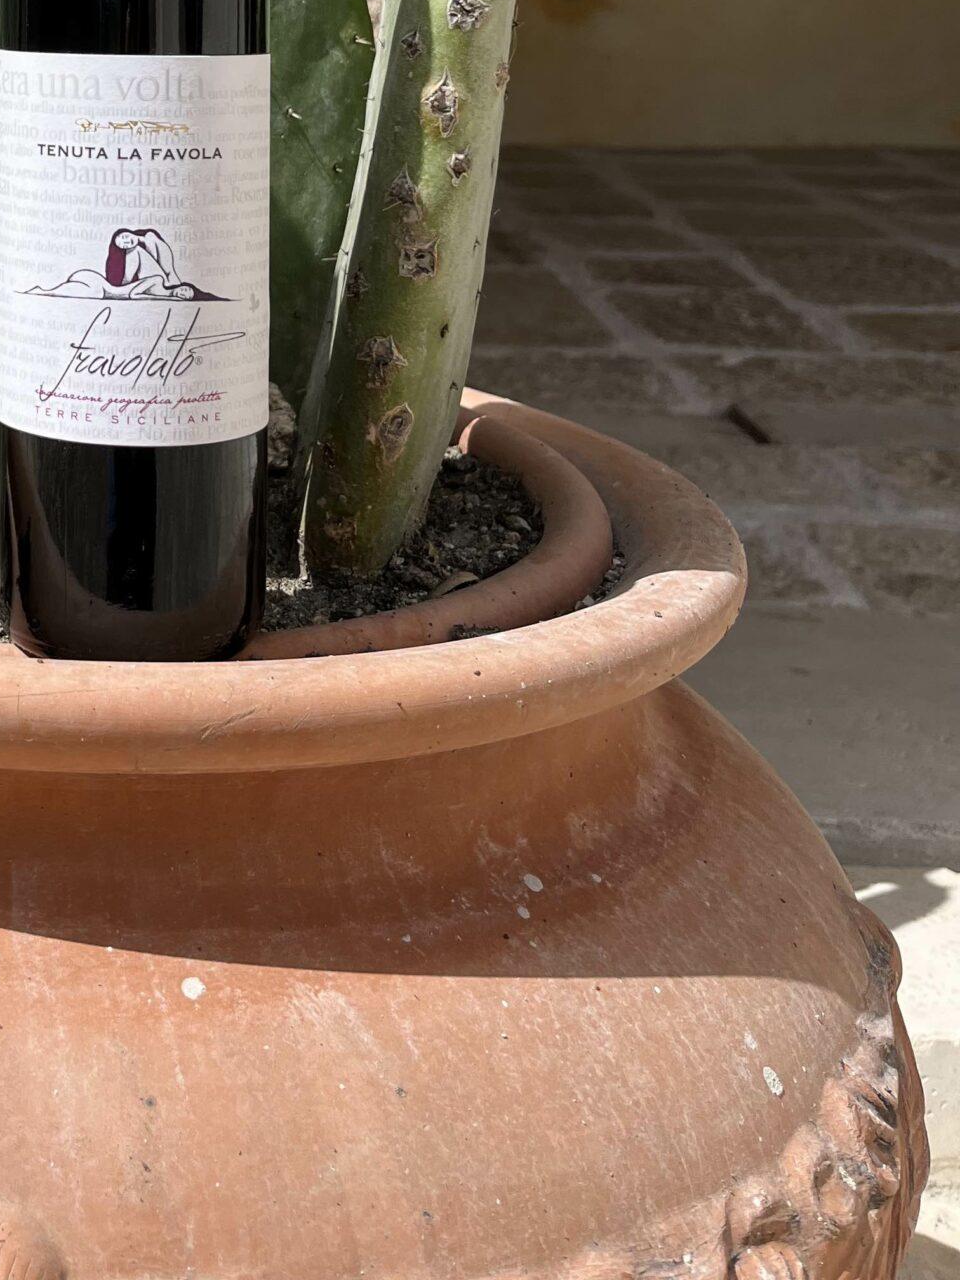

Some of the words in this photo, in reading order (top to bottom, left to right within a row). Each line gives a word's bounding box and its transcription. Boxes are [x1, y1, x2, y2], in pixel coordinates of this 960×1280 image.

[37, 71, 102, 101] una
[114, 66, 207, 102] volta
[37, 143, 108, 160] TENUTA
[117, 147, 143, 161] LA
[150, 146, 223, 161] FAVOLA
[62, 157, 178, 187] bambine
[171, 390, 228, 410] protetta
[35, 405, 93, 423] TERRE
[111, 412, 222, 425] SICILIANE
